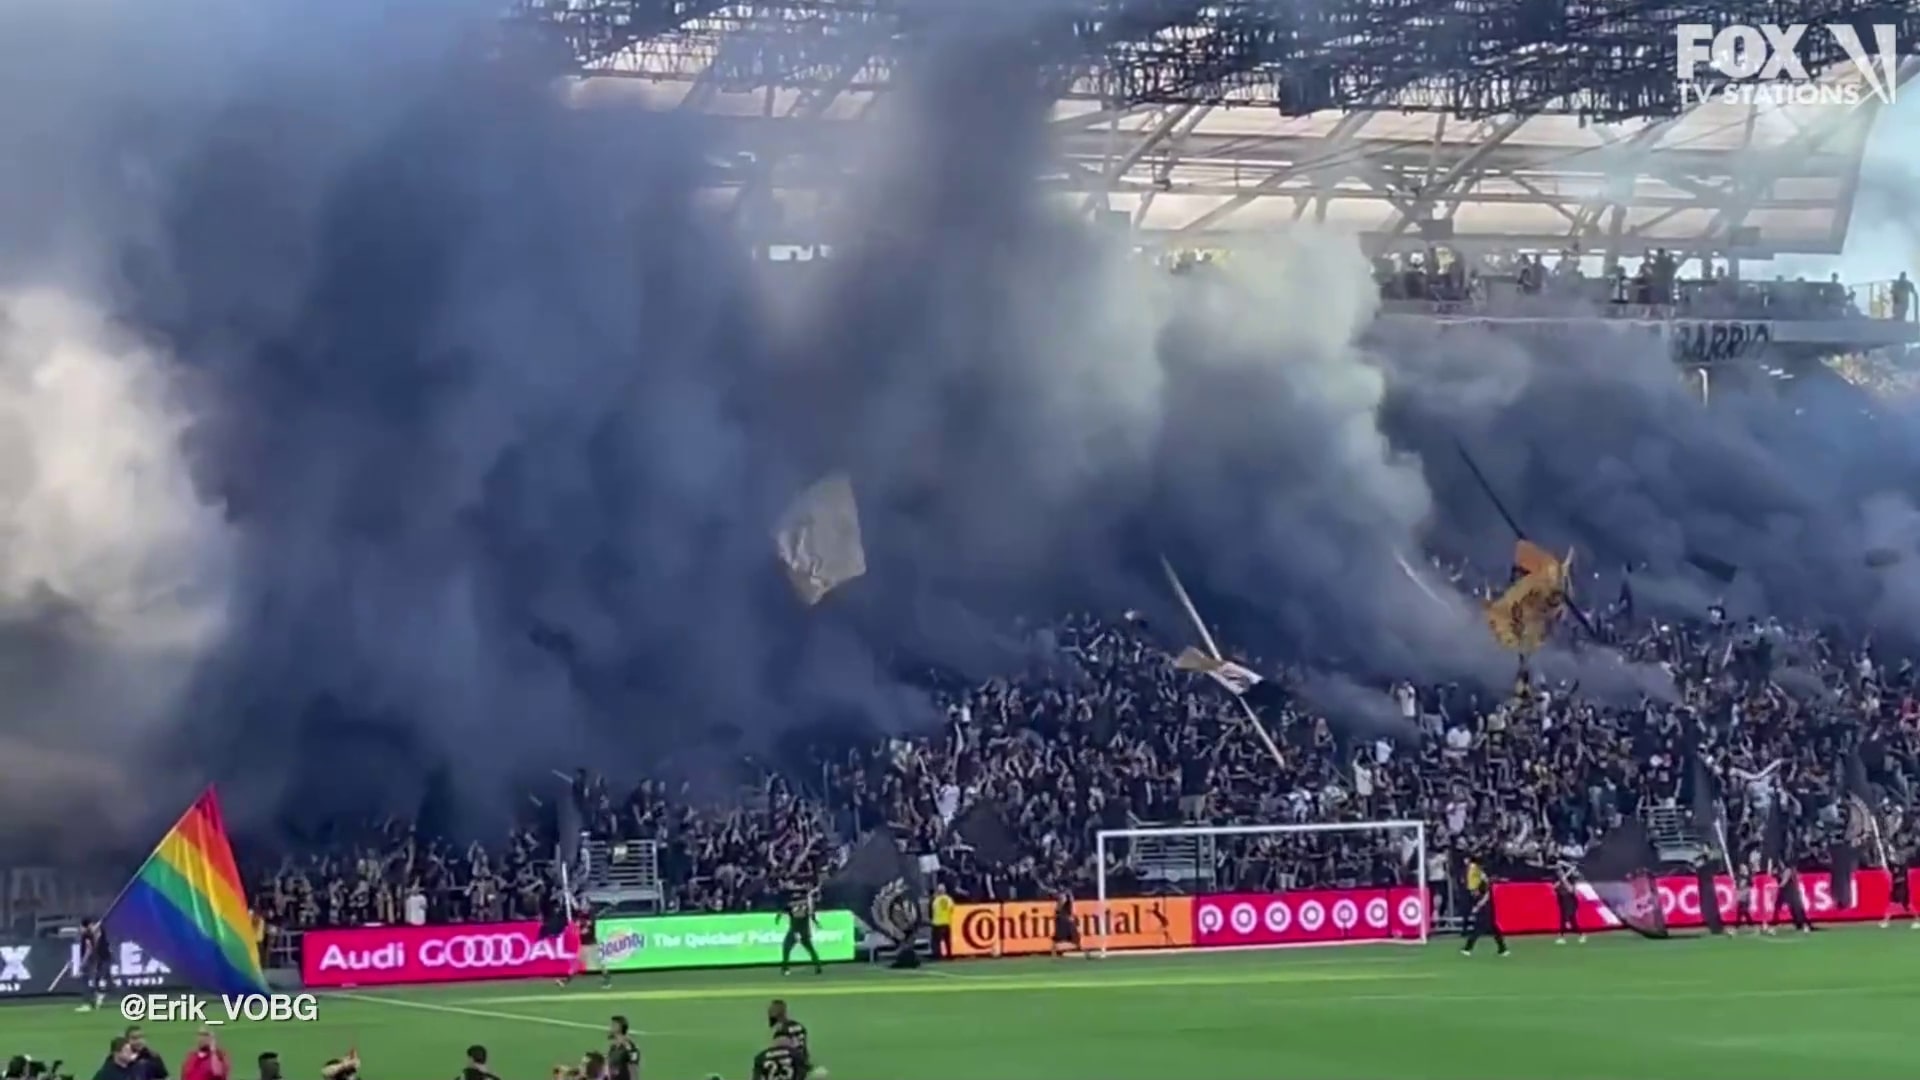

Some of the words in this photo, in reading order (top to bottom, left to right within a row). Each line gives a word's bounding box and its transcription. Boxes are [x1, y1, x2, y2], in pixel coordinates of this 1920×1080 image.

[1671, 321, 1769, 362] BARRIO
[962, 903, 1141, 949] Continntal
[319, 942, 404, 970] Audi
